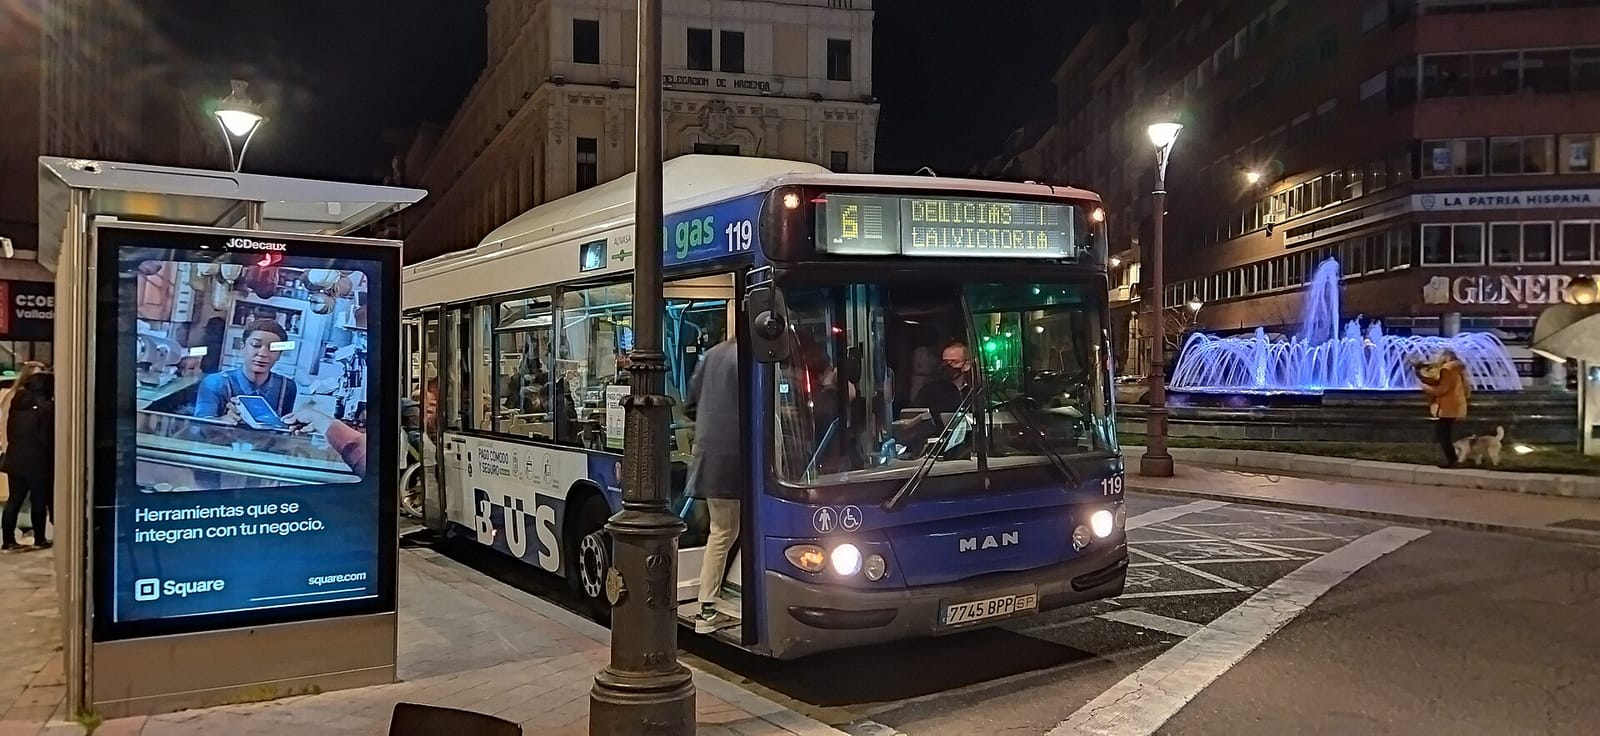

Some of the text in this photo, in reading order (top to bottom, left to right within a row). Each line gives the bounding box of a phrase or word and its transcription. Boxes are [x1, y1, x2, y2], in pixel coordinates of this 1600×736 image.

[716, 78, 727, 88] DE
[733, 80, 770, 91] HACIENDA
[1444, 193, 1591, 207] LA PATRIA HISPANA
[226, 238, 287, 252] JCDecaux
[675, 216, 714, 260] gas
[725, 220, 753, 252] 119
[1101, 476, 1122, 496] 119
[135, 502, 299, 522] Herramientas que se
[135, 517, 325, 544] integran con tu negocio.
[474, 487, 560, 573] BUS
[959, 531, 1019, 552] MAN
[163, 578, 225, 597] Square
[308, 571, 367, 586] square.com
[949, 597, 1014, 623] 7745 BPP
[1016, 596, 1034, 609] SP
